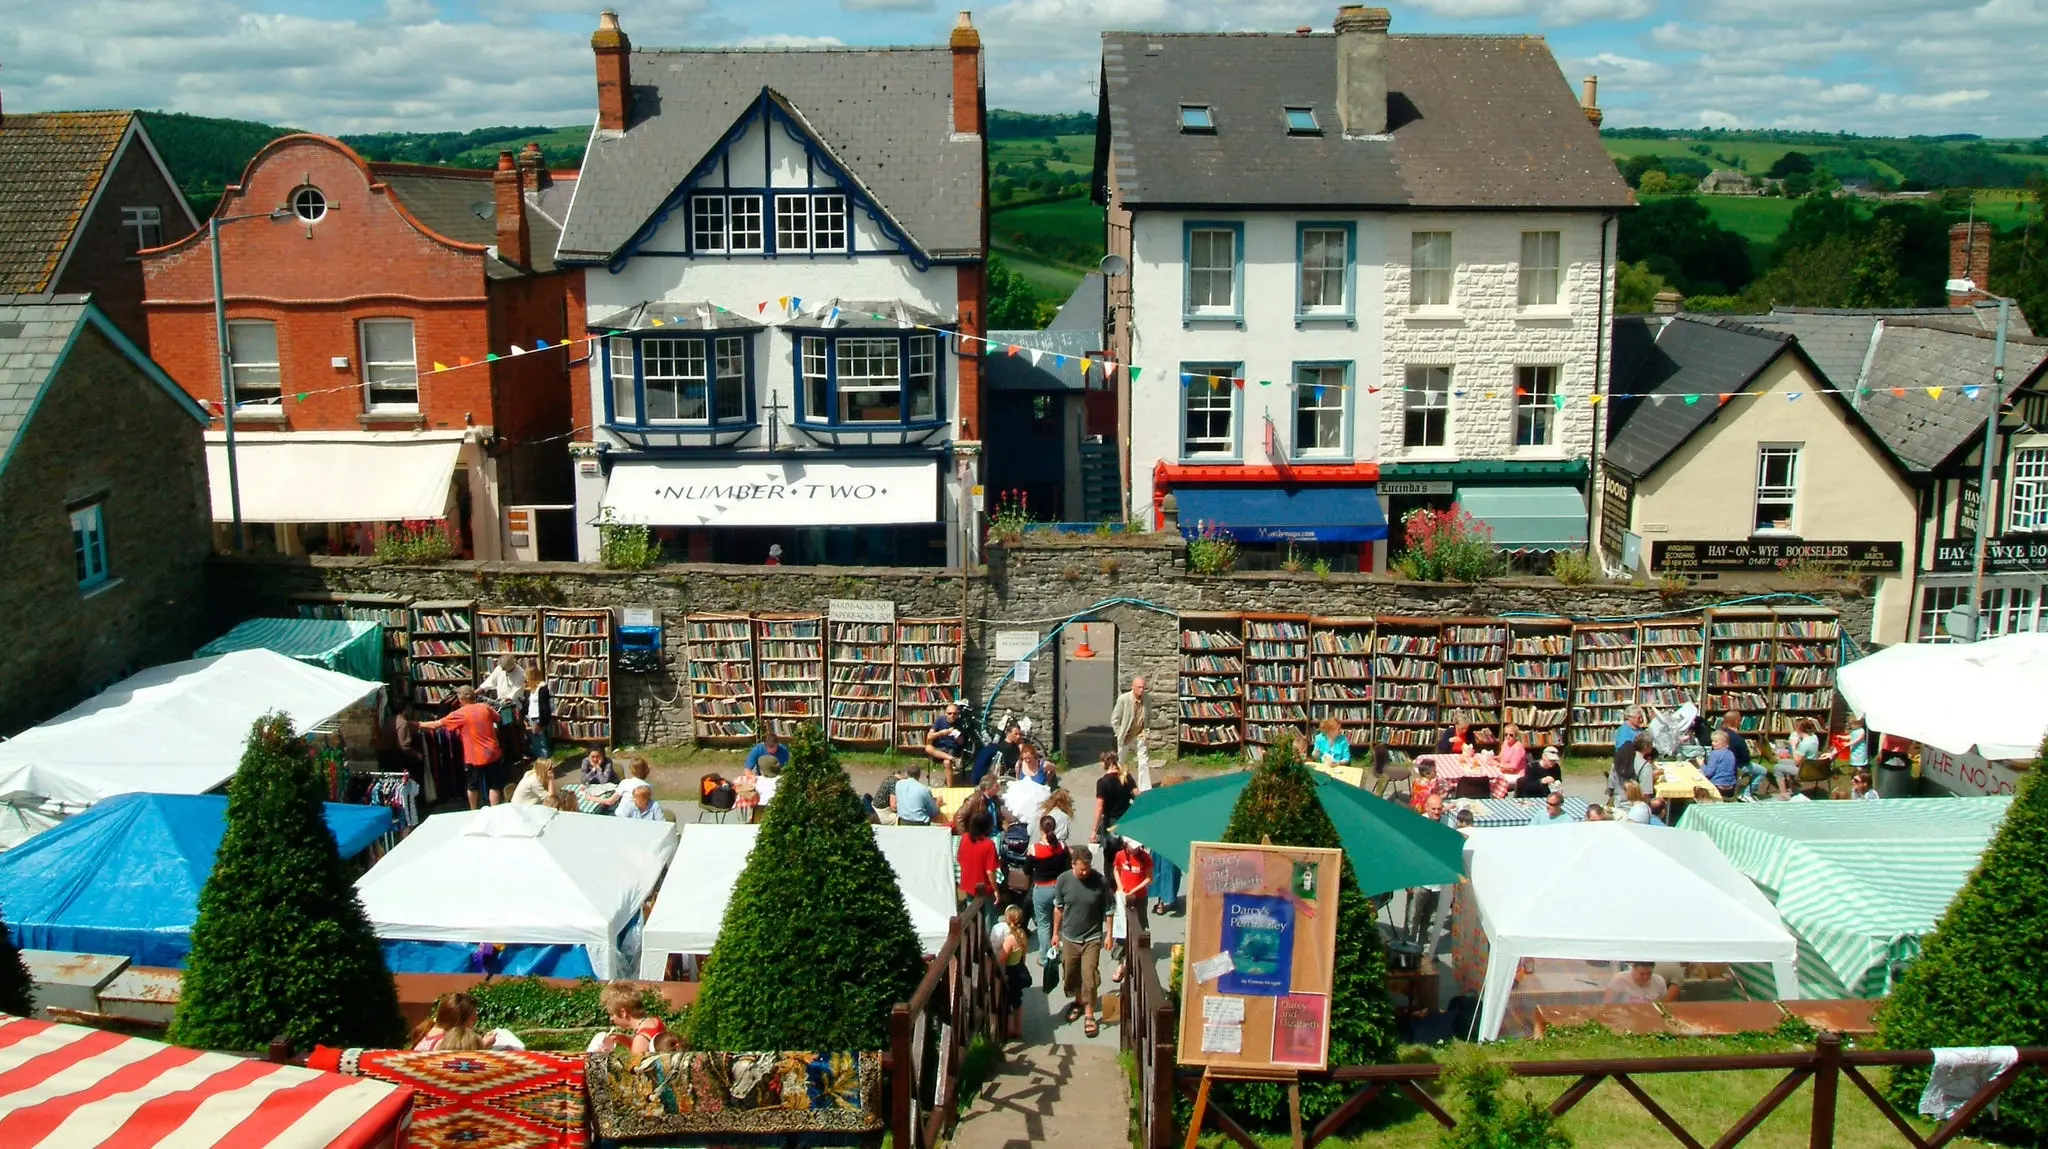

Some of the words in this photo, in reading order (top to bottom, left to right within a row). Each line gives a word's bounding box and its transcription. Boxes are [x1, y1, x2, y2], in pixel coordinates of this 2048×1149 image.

[664, 484, 785, 500] NUMBER
[804, 484, 876, 499] TWO
[1381, 481, 1428, 492] Lucinda's
[1605, 478, 1627, 500] BOOKS
[1964, 489, 1980, 504] HAY
[1964, 506, 1979, 519] WYE
[1786, 545, 1849, 556] BOOKSELLERS
[1939, 547, 1966, 560] HAY
[830, 602, 874, 610] HARDBACKS
[1925, 745, 1954, 777] THE
[1205, 867, 1229, 881] and
[1231, 904, 1270, 916] Darcy's
[1280, 1000, 1306, 1011] Darcy
[1280, 1010, 1297, 1018] and
[1280, 1018, 1320, 1028] Elizabeth
